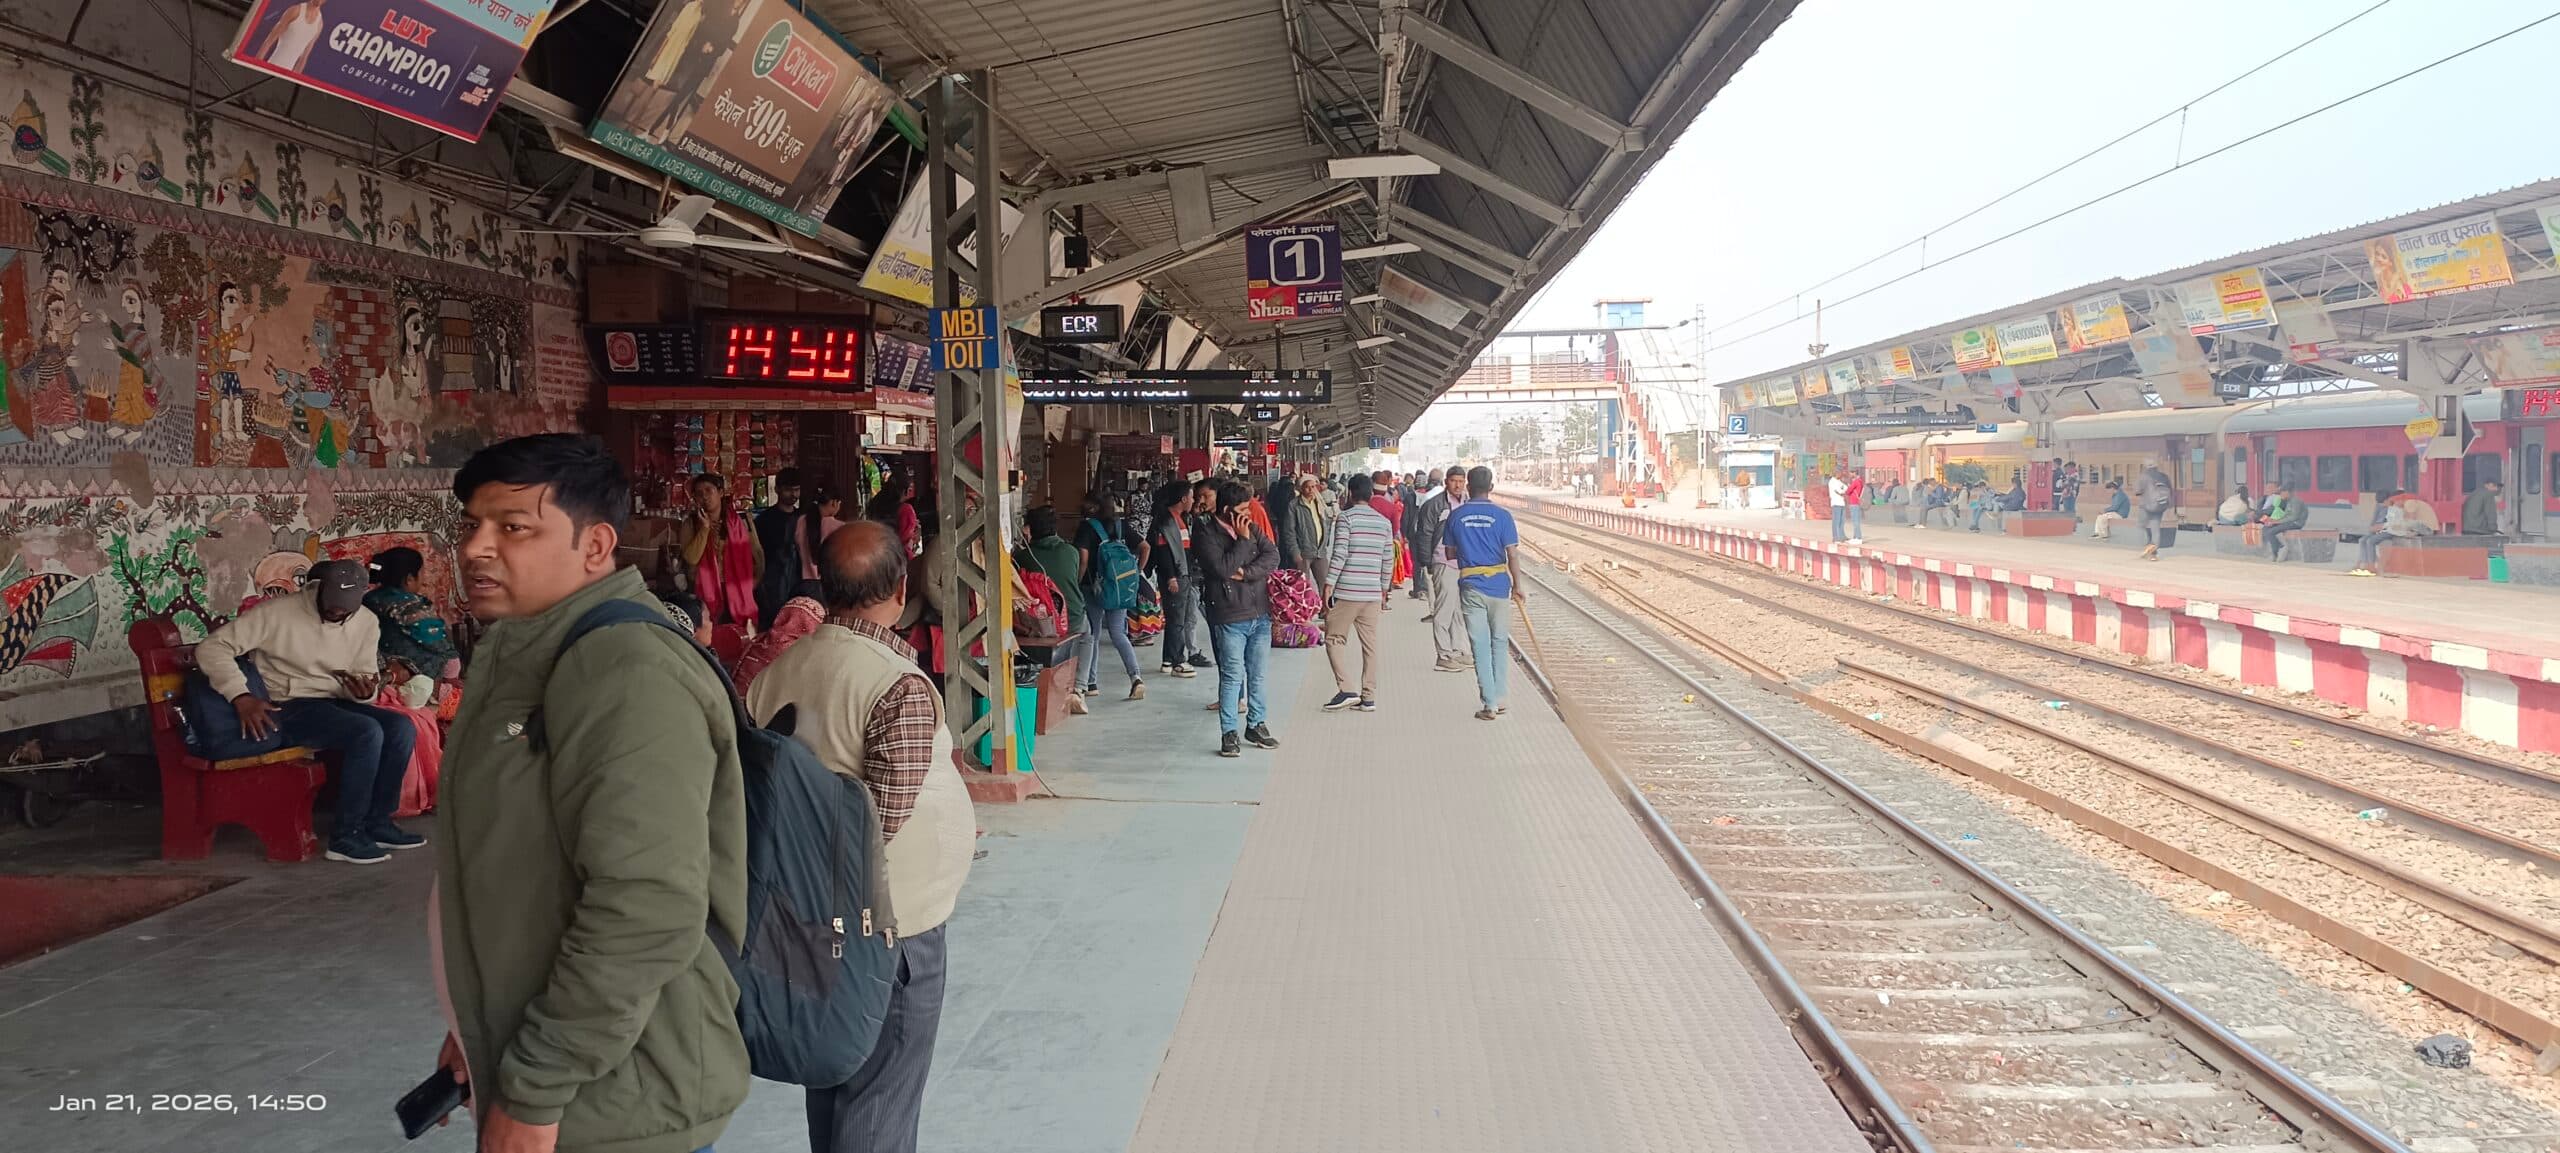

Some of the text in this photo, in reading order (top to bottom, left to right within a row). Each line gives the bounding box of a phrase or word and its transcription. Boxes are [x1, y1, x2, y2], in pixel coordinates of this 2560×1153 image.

[380, 9, 437, 48] LUX
[329, 22, 451, 92] CHAMPION
[784, 46, 832, 94] Citykart
[341, 63, 417, 97] COMFORT WEAR
[603, 130, 632, 151] MEN'S
[630, 140, 653, 160] WEAR
[682, 164, 704, 184] WEAR
[1284, 241, 1306, 278] 1
[941, 308, 985, 337] MBI
[1062, 316, 1098, 333] ECR
[2223, 384, 2240, 393] ECR
[1733, 418, 1743, 431] 2
